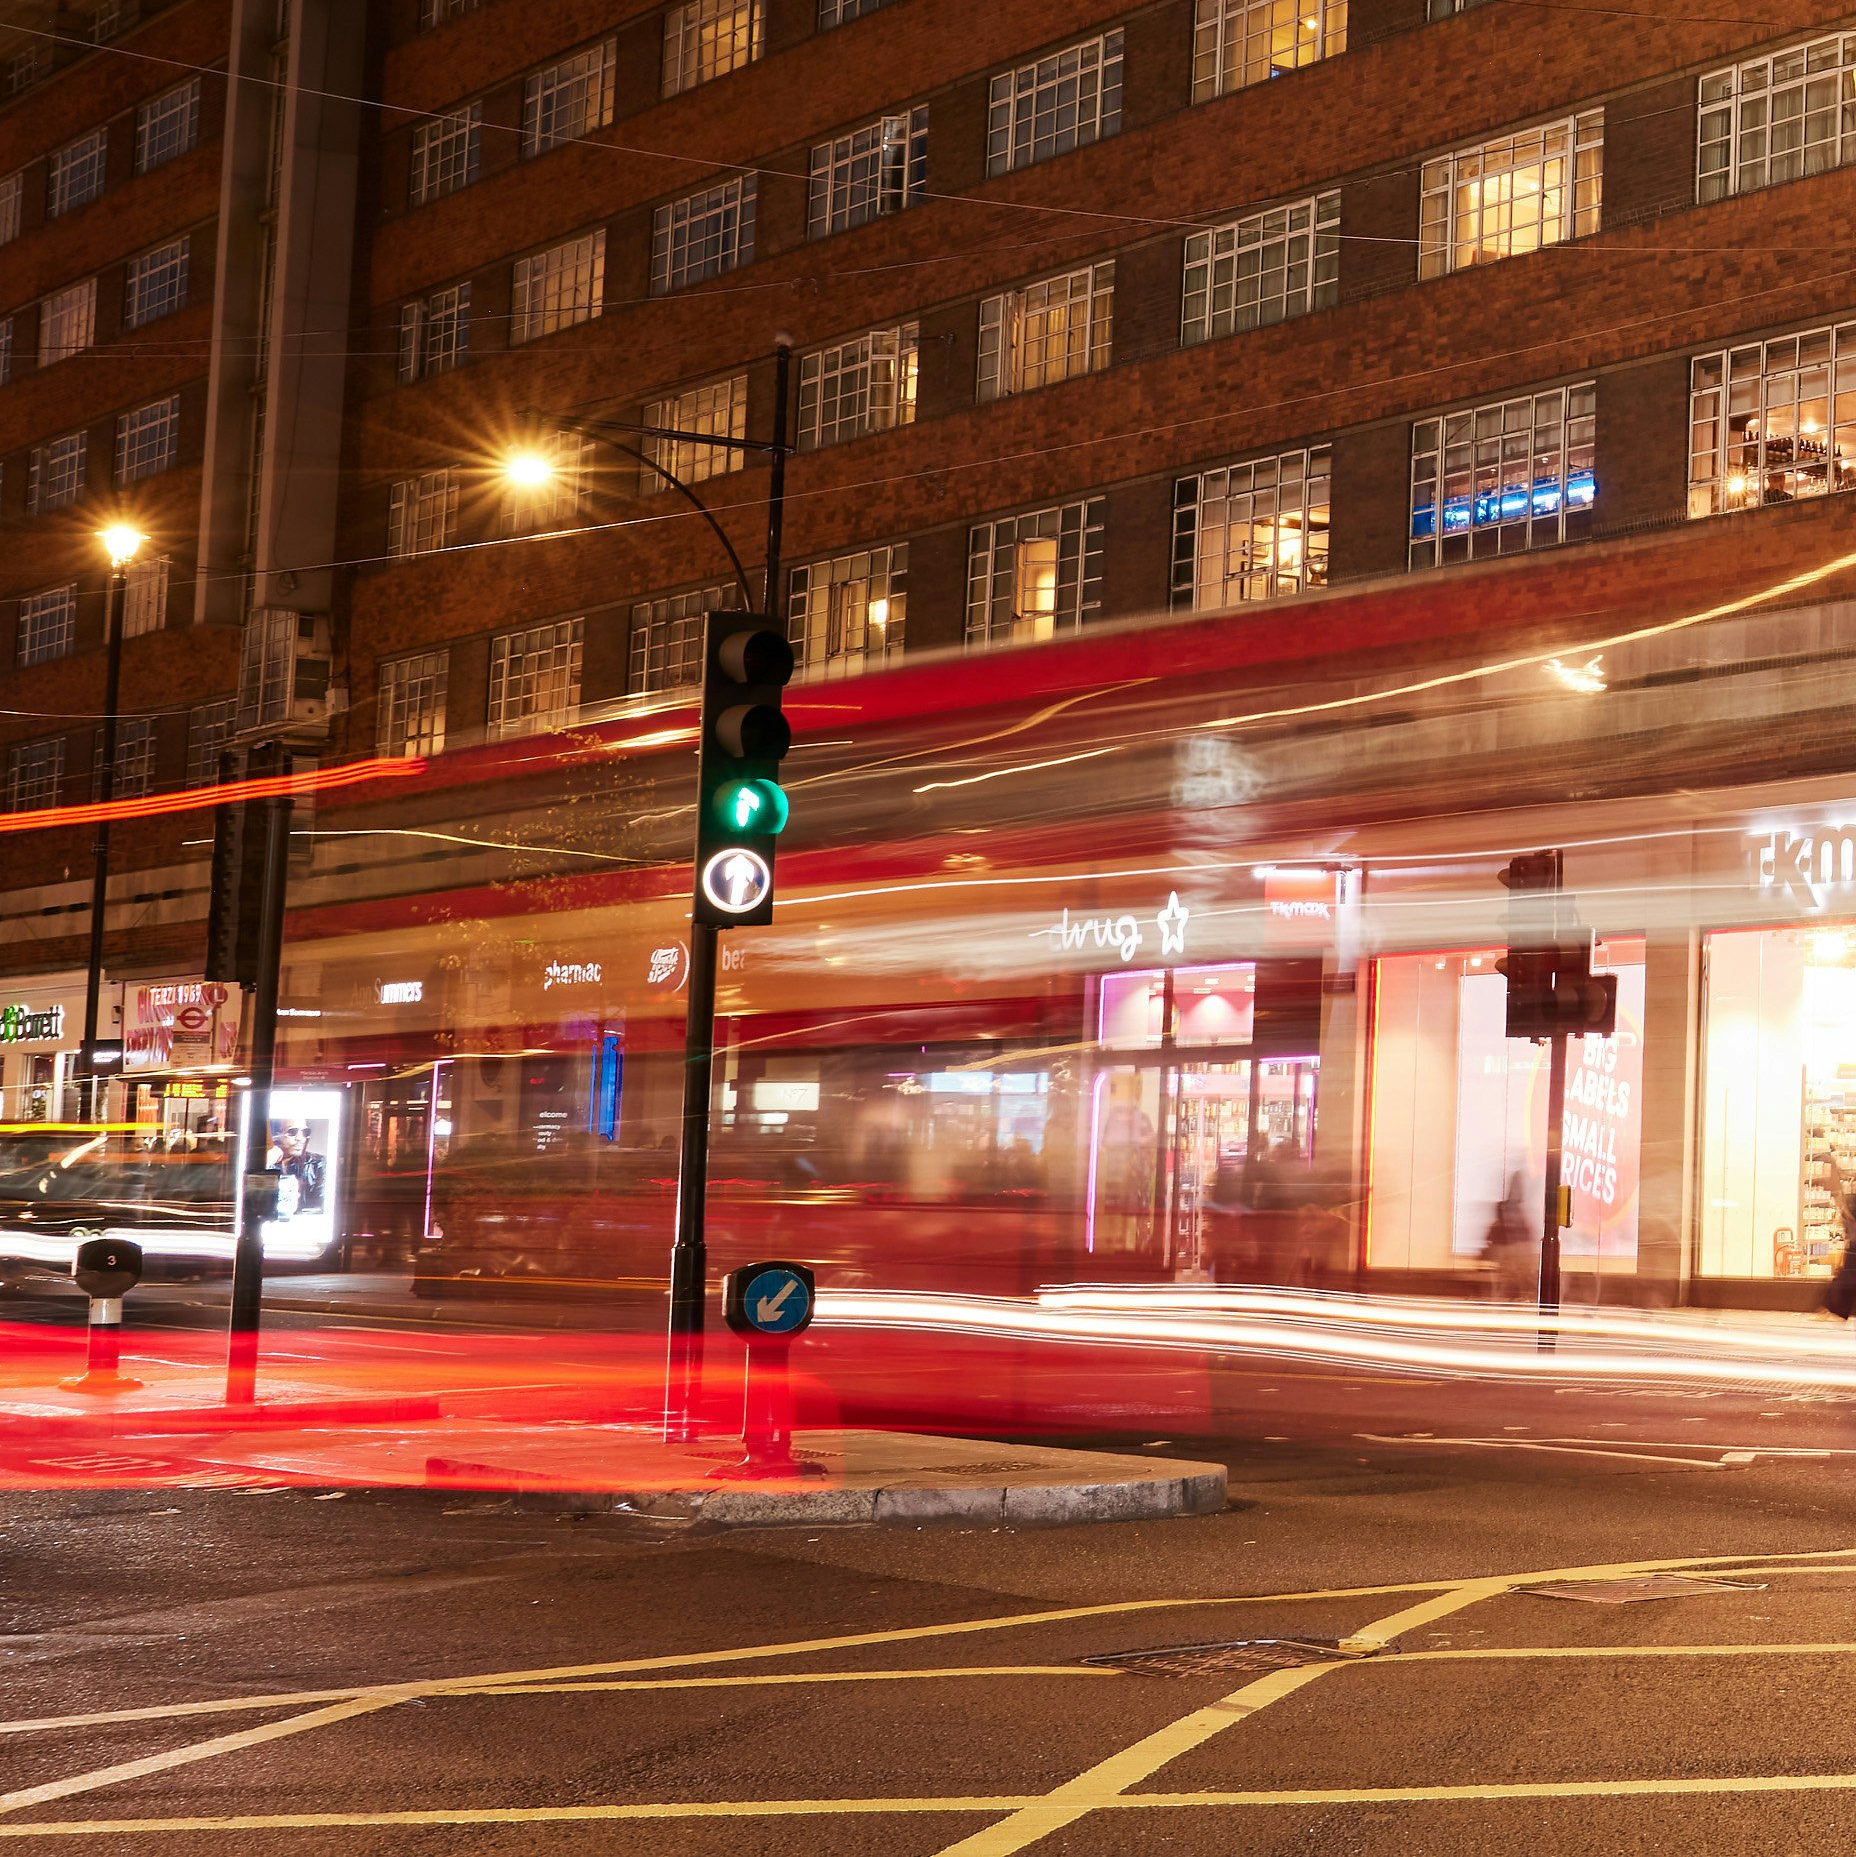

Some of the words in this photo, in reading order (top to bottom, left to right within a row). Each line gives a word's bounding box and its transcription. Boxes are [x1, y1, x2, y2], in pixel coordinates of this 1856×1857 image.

[543, 959, 603, 992] pharmac
[1583, 1033, 1618, 1073] BIG
[1564, 1067, 1630, 1119] ABELS
[1562, 1109, 1617, 1165] SMALL
[1560, 1150, 1617, 1205] RICES
[107, 1255, 117, 1266] 3
